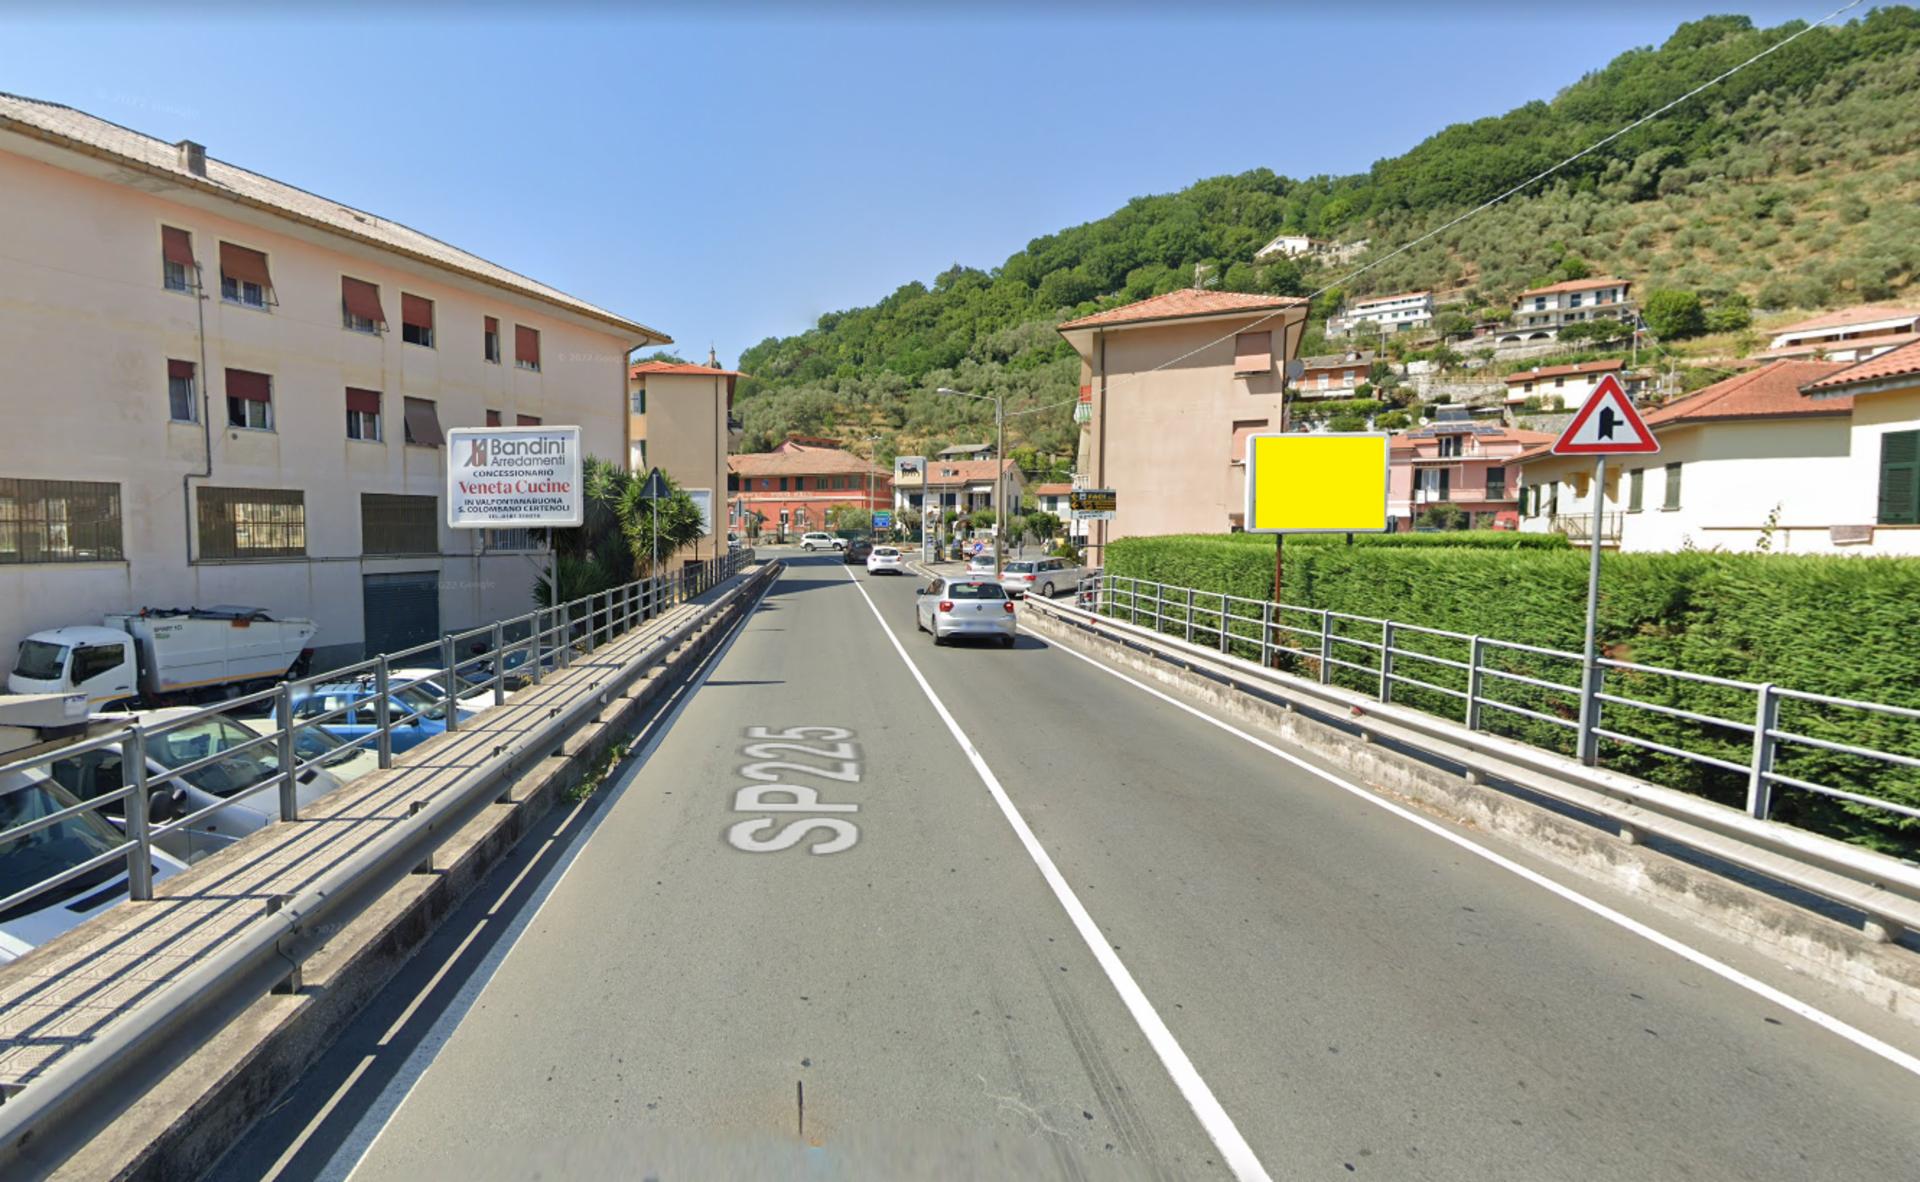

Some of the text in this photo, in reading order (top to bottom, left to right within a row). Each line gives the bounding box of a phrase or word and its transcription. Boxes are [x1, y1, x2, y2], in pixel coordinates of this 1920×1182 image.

[491, 437, 565, 455] Bandini
[491, 455, 565, 467] Arredamenti
[459, 478, 571, 495] Veneta Cucine
[464, 498, 475, 506] IN
[467, 505, 522, 513] COLOMBANO
[728, 726, 860, 855] SP225
